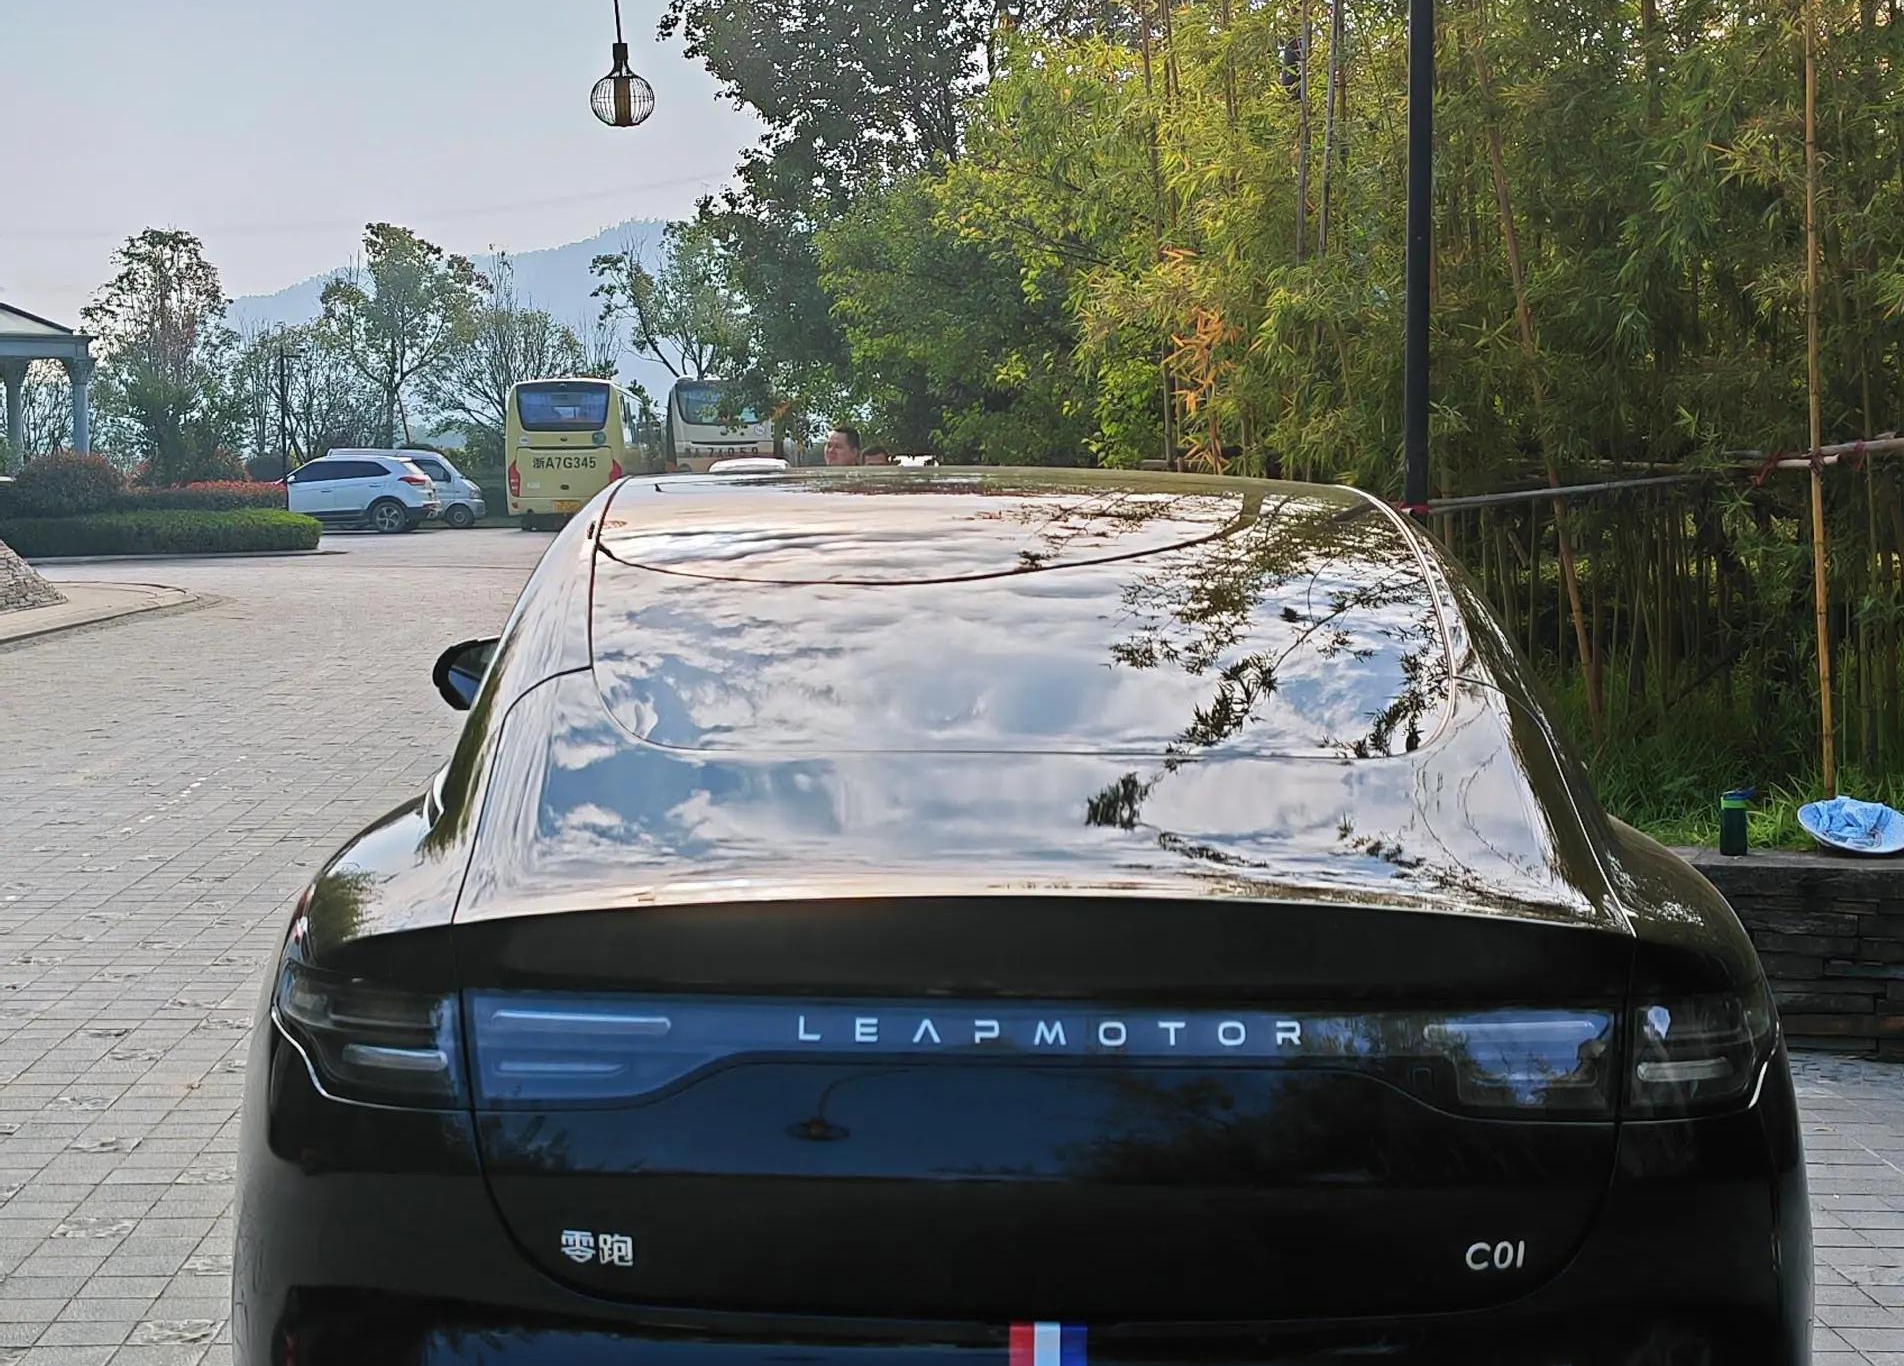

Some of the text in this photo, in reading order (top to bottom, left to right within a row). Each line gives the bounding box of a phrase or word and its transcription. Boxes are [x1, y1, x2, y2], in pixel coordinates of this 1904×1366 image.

[533, 456, 597, 469] 浙A7G345
[799, 1016, 1302, 1046] LEAPMOTOR
[561, 1229, 634, 1267] 零跑
